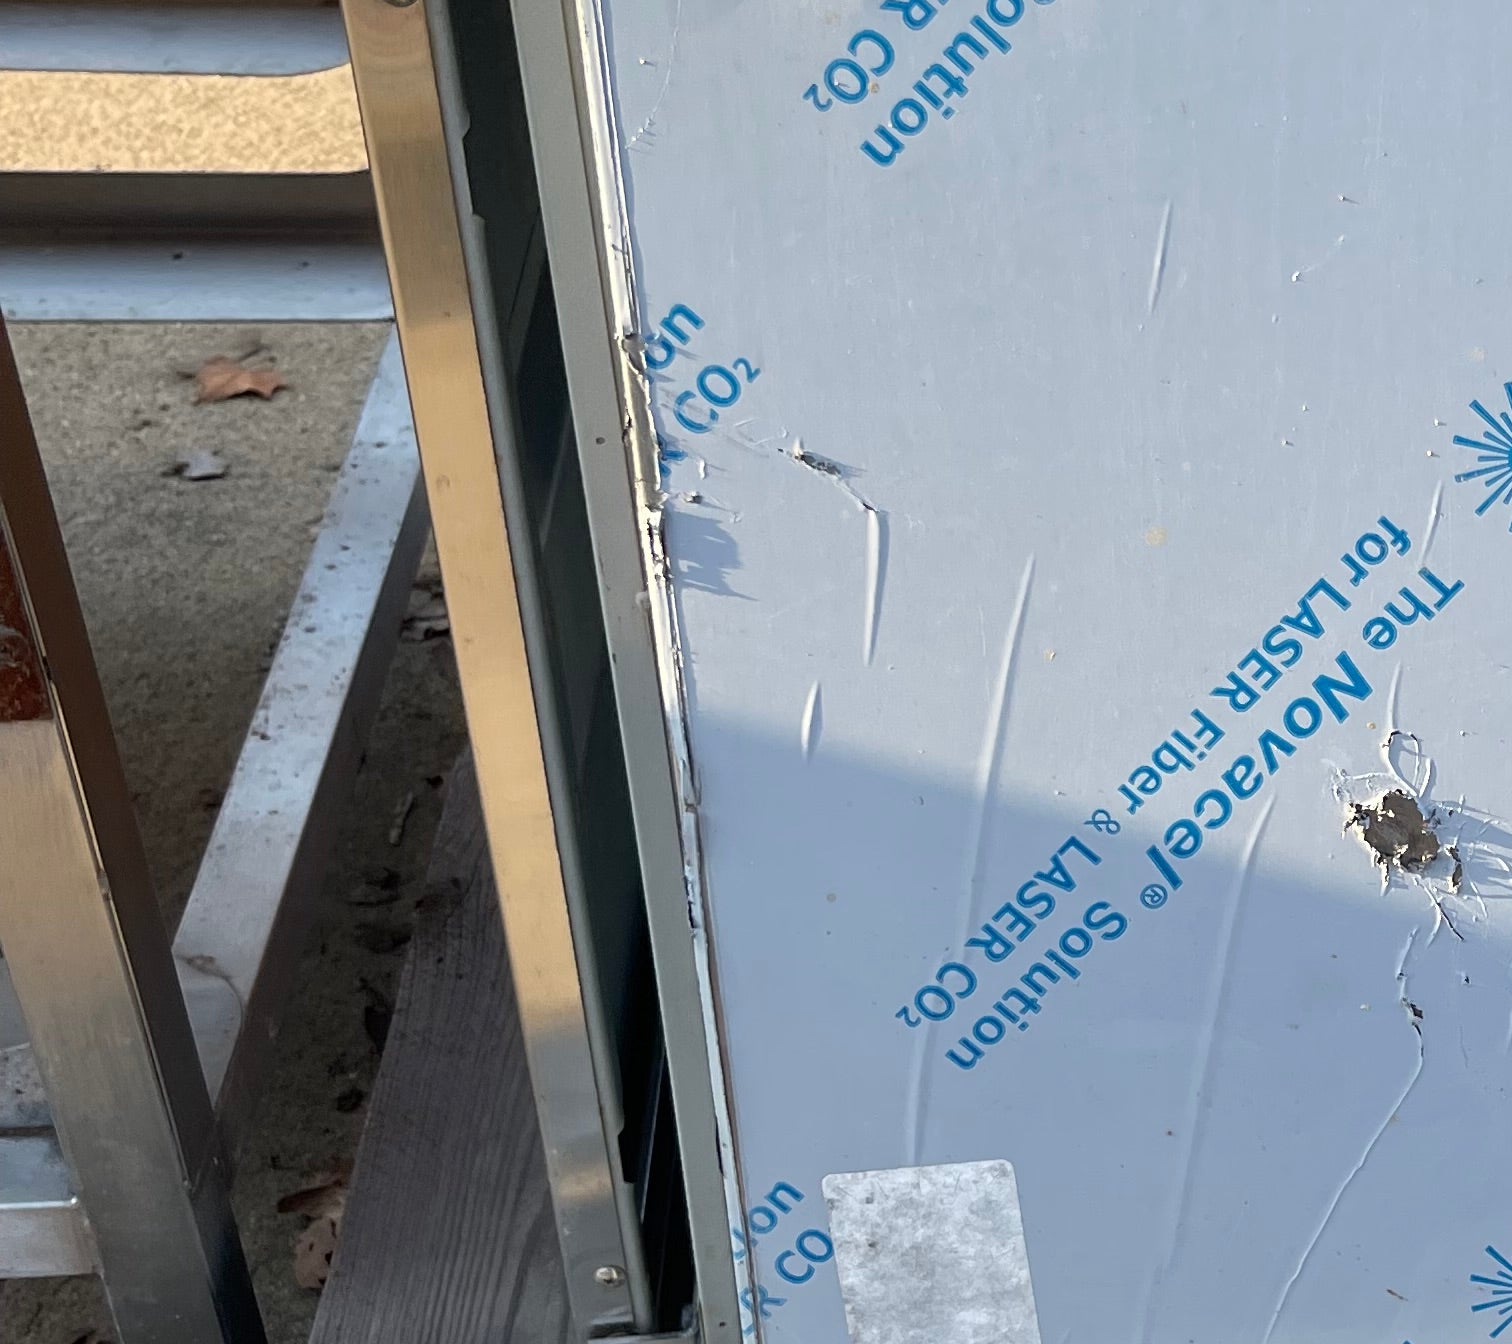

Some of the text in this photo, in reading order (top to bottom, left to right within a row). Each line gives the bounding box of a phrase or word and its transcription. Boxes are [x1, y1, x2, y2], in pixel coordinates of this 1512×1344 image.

[1340, 515, 1412, 586] for
[1210, 578, 1350, 713] LASER
[1362, 567, 1465, 650] The
[1118, 709, 1224, 814] Fiber
[1085, 808, 1122, 837] &
[965, 835, 1101, 962] LASER
[945, 900, 1128, 1070] Solution
